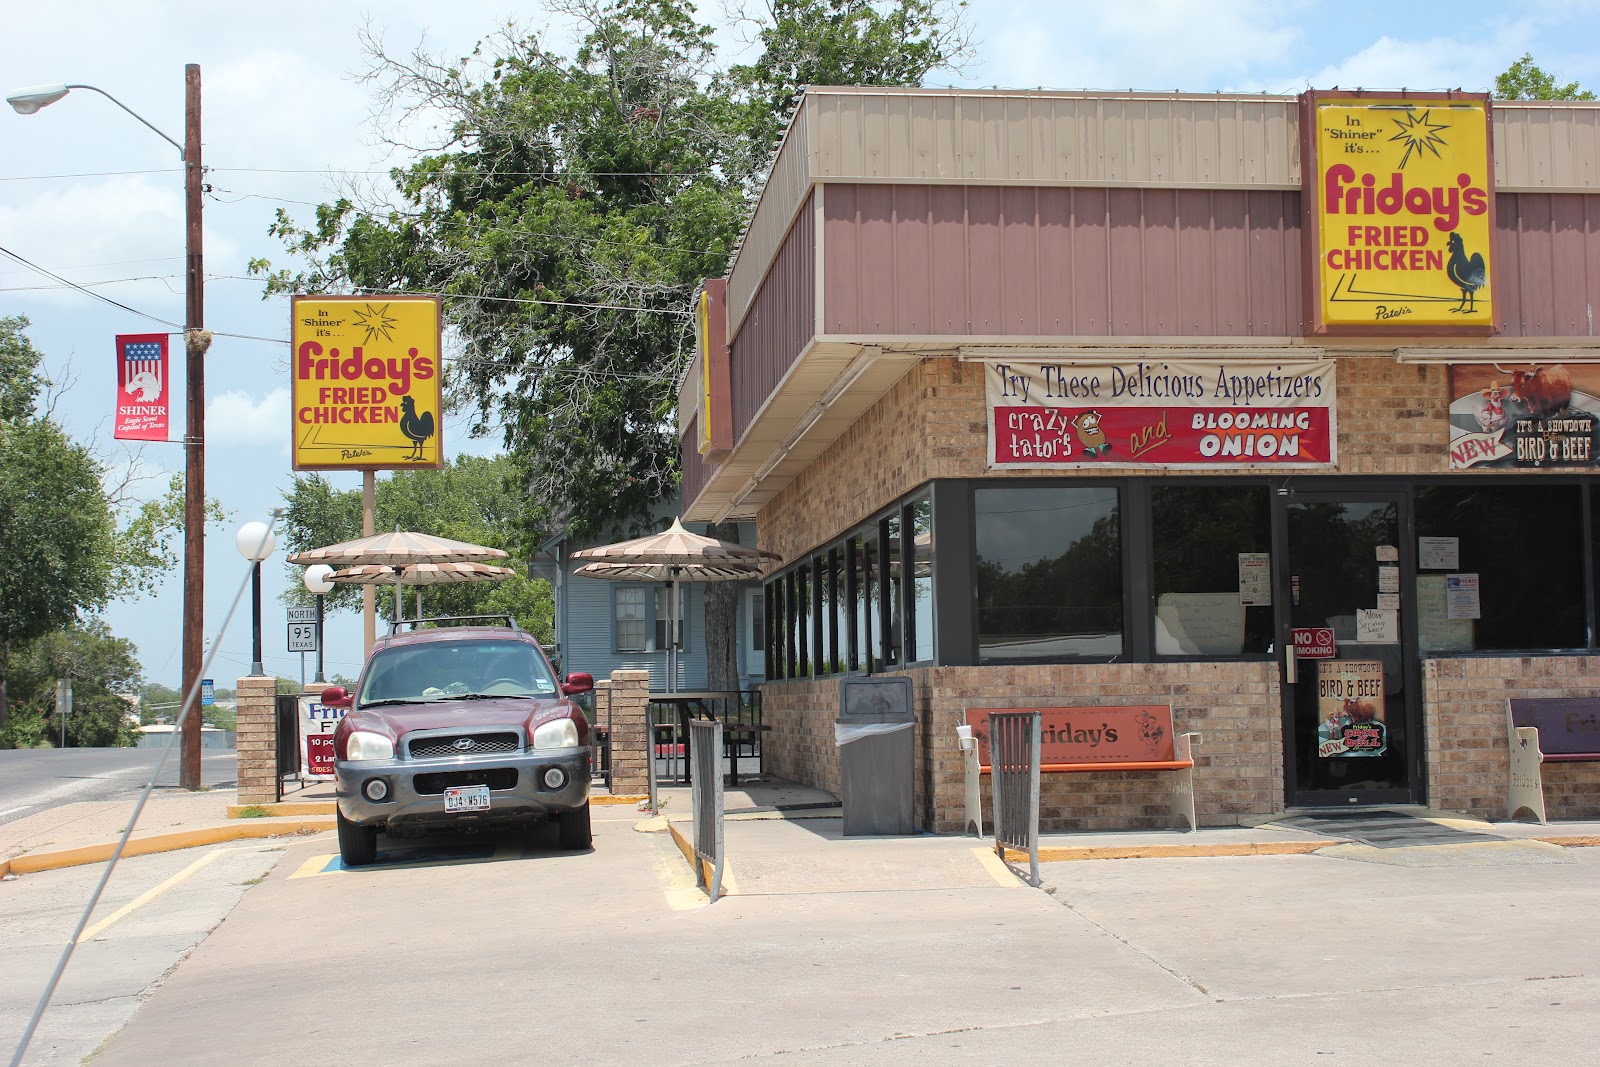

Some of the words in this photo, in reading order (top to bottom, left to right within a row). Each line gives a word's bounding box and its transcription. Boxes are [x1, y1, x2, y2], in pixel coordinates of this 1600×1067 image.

[1345, 115, 1361, 127] In
[1325, 163, 1488, 232] friday's
[1347, 225, 1429, 247] FRIED
[1327, 249, 1444, 271] CHICKEN
[318, 309, 329, 317] In
[298, 340, 434, 396] friday's
[996, 364, 1032, 403] Try
[1040, 365, 1101, 399] These
[1110, 362, 1204, 399] Delicious
[1214, 364, 1323, 406] Appetizers
[319, 387, 387, 404] FRIED
[119, 405, 167, 416] SHINER
[298, 406, 399, 424] CHICKEN
[1191, 412, 1310, 430] BLOOMING
[1516, 420, 1533, 433] IT'S
[1537, 420, 1544, 433] A
[1547, 420, 1592, 433] SHOWDOWN
[1130, 411, 1172, 455] and
[1198, 433, 1301, 458] ONION
[1450, 437, 1496, 464] NEW
[1516, 437, 1545, 461] BIRD
[1549, 438, 1559, 461] &
[1562, 437, 1592, 461] BEEF
[288, 611, 315, 619] NORTH
[293, 627, 312, 639] 95
[1294, 632, 1313, 645] NO
[1296, 646, 1333, 655] MOKING
[1320, 680, 1343, 697] BIRD
[1347, 680, 1354, 697] &
[1357, 680, 1381, 697] BEEF
[1024, 722, 1119, 748] riday's
[1319, 742, 1342, 756] NEW
